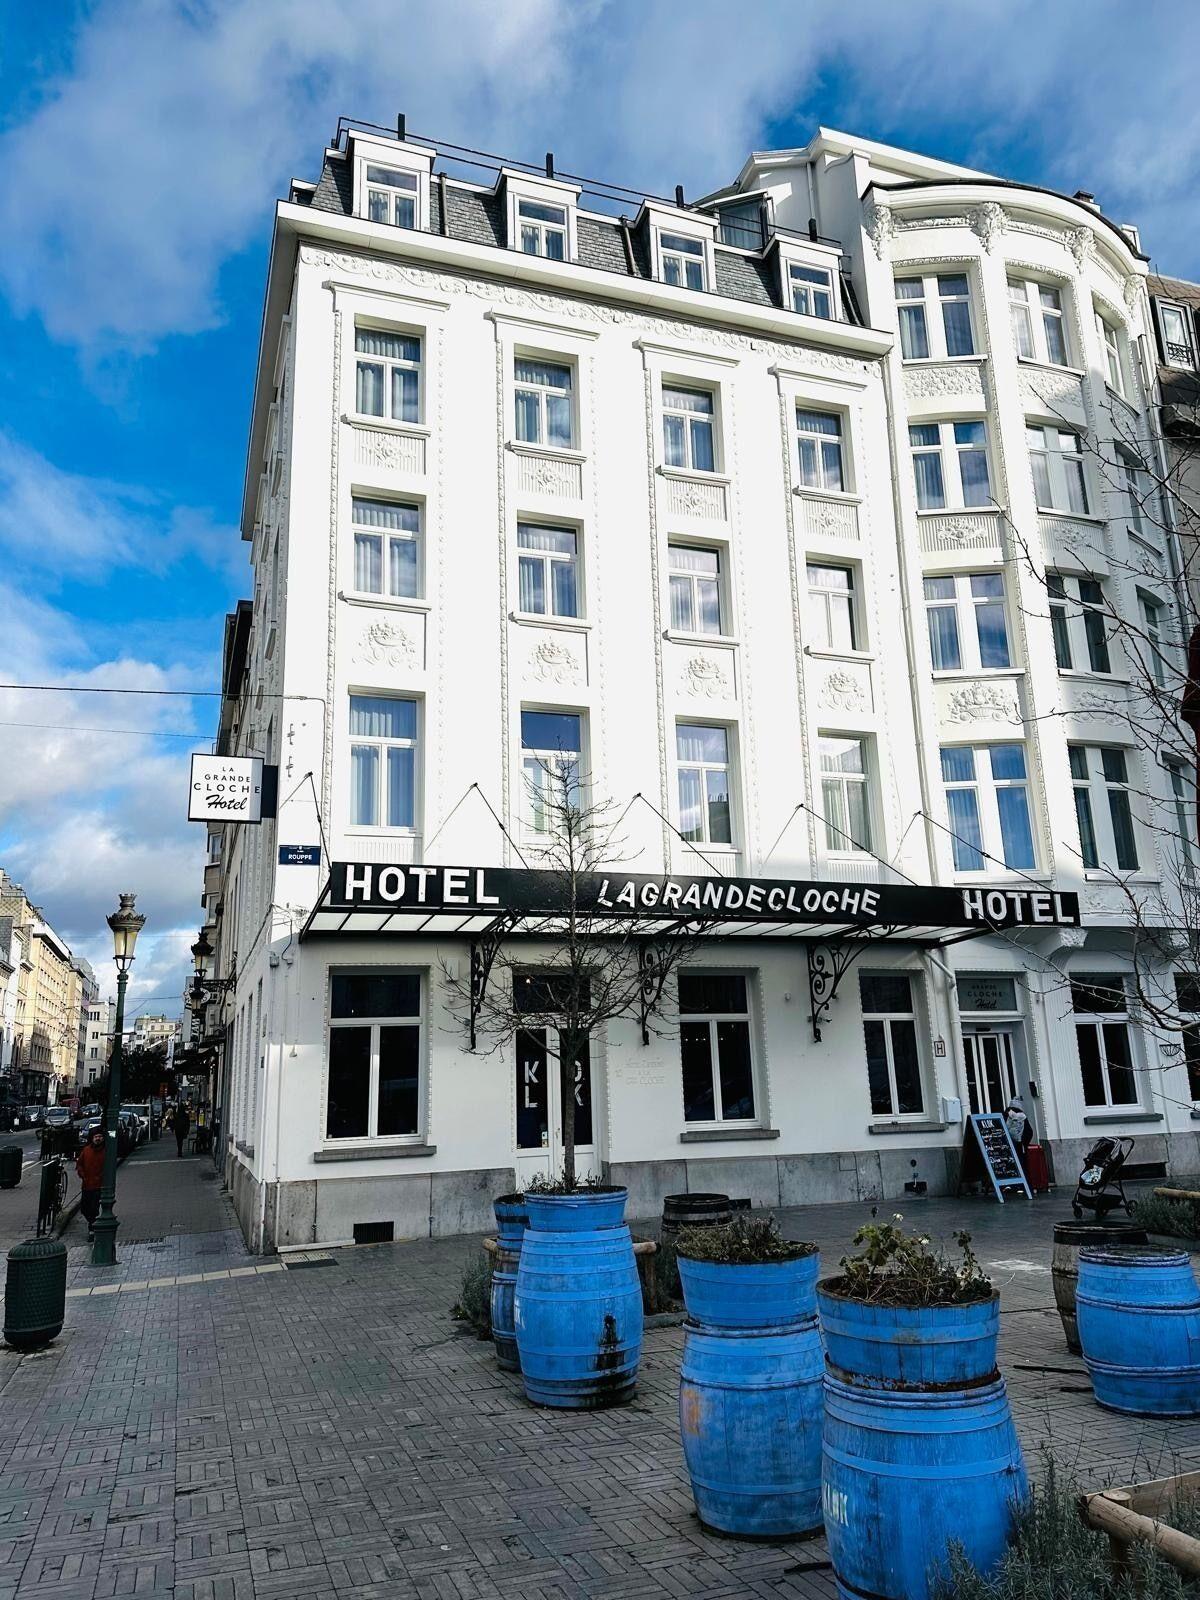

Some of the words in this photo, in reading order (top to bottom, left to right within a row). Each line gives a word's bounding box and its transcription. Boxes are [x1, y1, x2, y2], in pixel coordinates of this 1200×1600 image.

[204, 773, 251, 783] GRANDE
[193, 782, 261, 794] CLOCHE
[205, 794, 248, 810] Hotel
[288, 853, 313, 861] ROUPPE
[345, 864, 499, 904] HOTEL
[962, 889, 1075, 923] HOTEL
